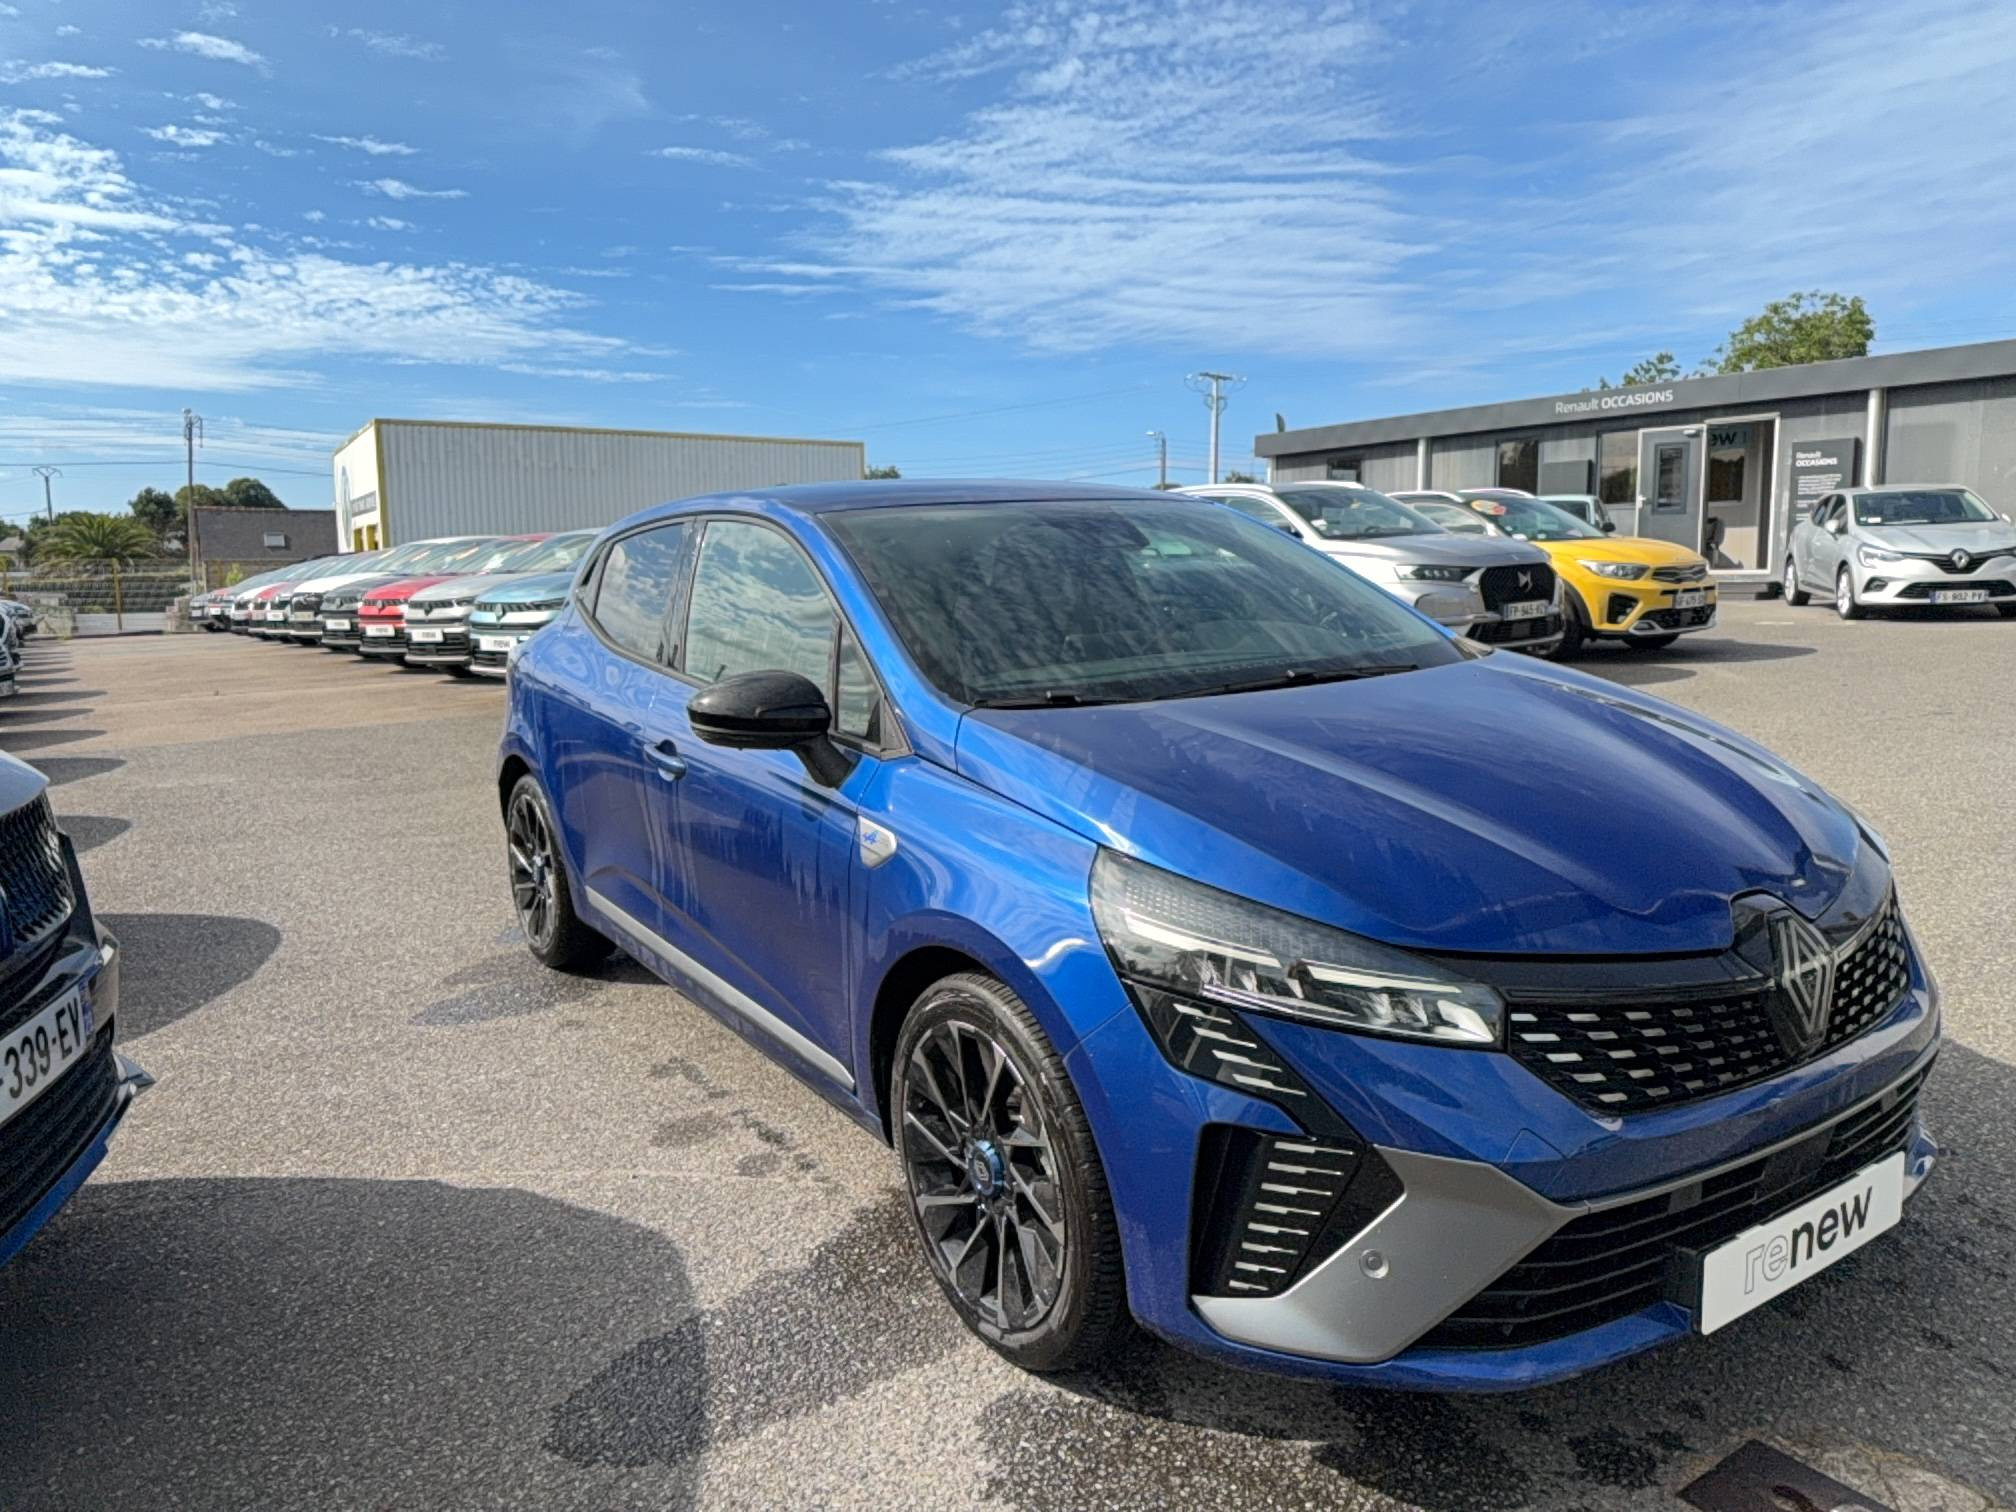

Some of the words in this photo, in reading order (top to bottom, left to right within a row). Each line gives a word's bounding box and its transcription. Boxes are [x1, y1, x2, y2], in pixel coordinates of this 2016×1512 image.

[1555, 398, 1599, 414] Renault
[1601, 389, 1674, 409] OCCASIONS
[1744, 1186, 1873, 1295] renew
